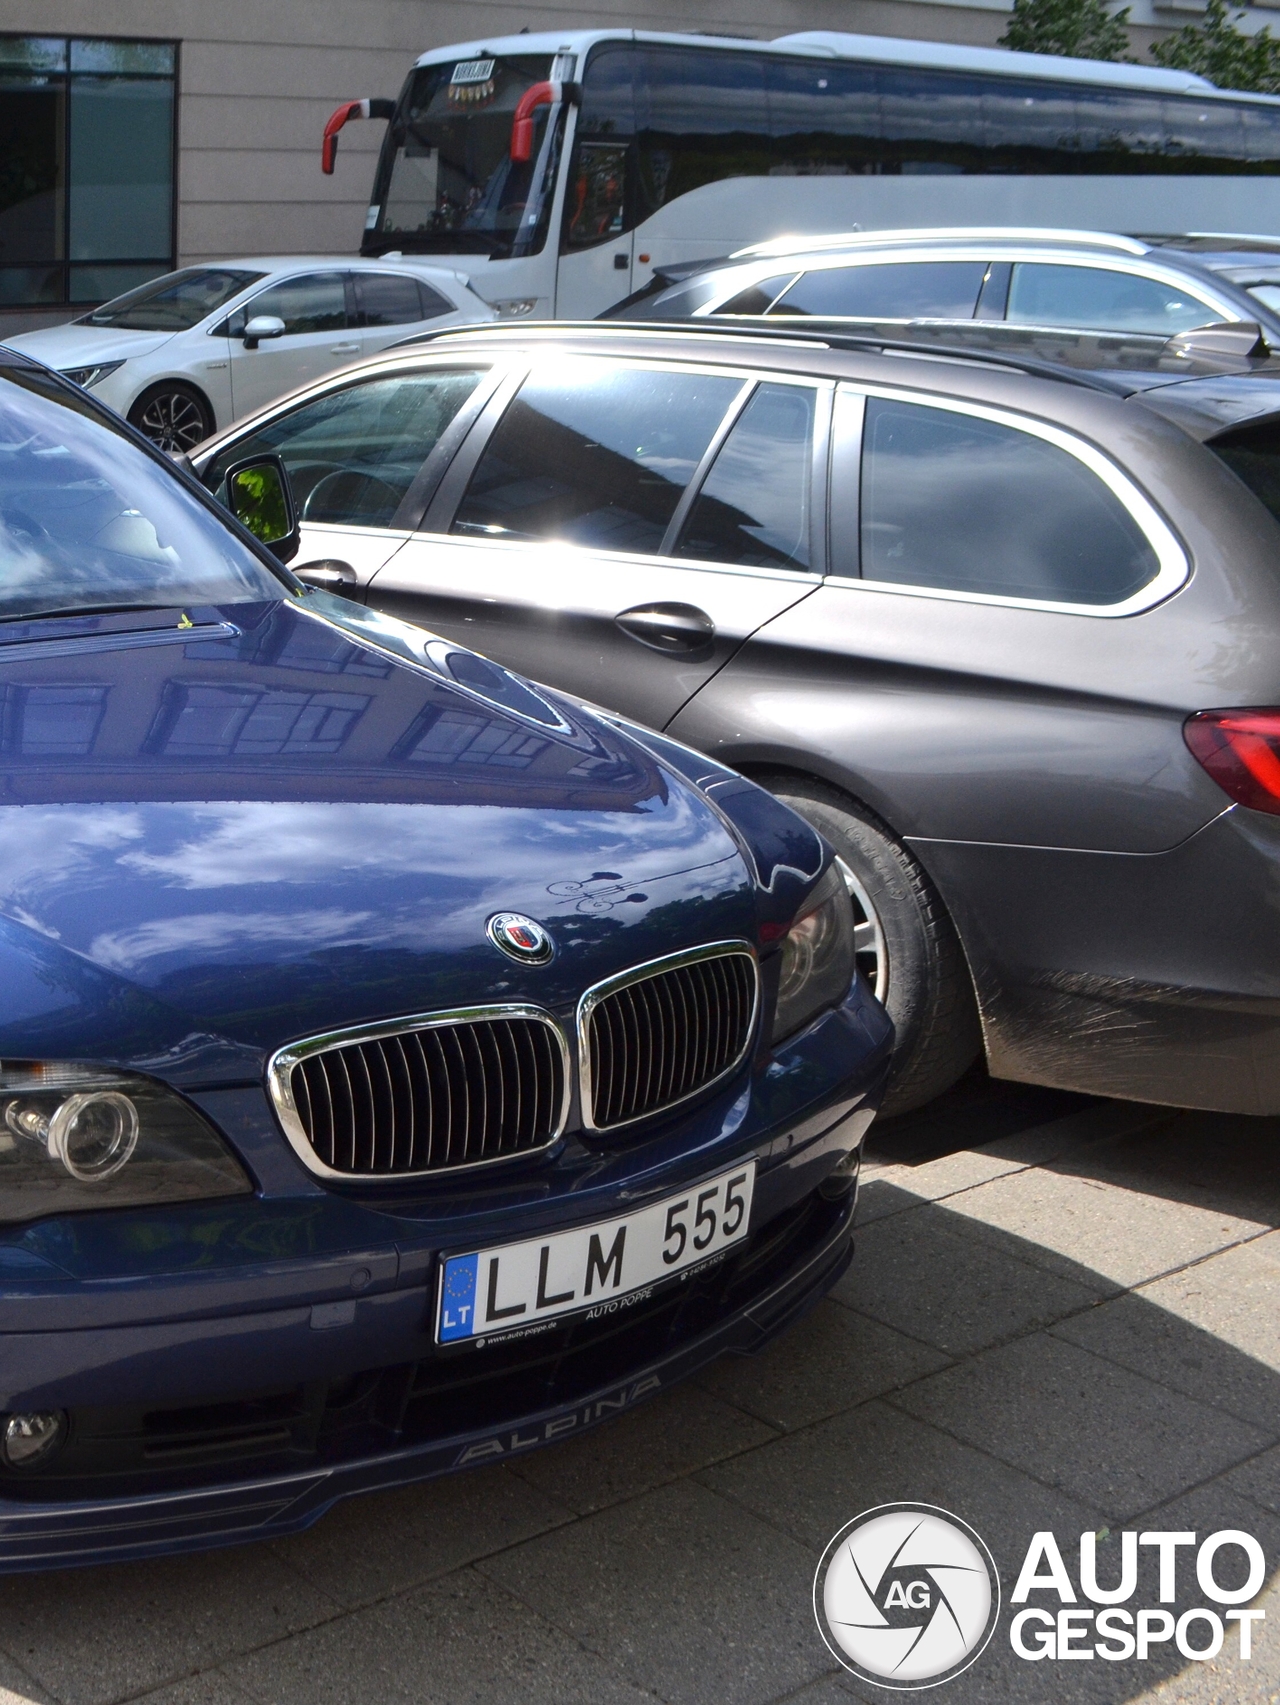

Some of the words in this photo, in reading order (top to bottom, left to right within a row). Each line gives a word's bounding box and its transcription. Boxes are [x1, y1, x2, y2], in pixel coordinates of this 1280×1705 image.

[485, 1225, 627, 1323] LLM
[662, 1173, 747, 1265] 555
[443, 1305, 471, 1328] LT
[586, 1302, 618, 1320] AUTO
[620, 1288, 654, 1308] POPPE
[487, 1321, 557, 1345] www.auto-poppe.de
[458, 1374, 662, 1464] ALPINA
